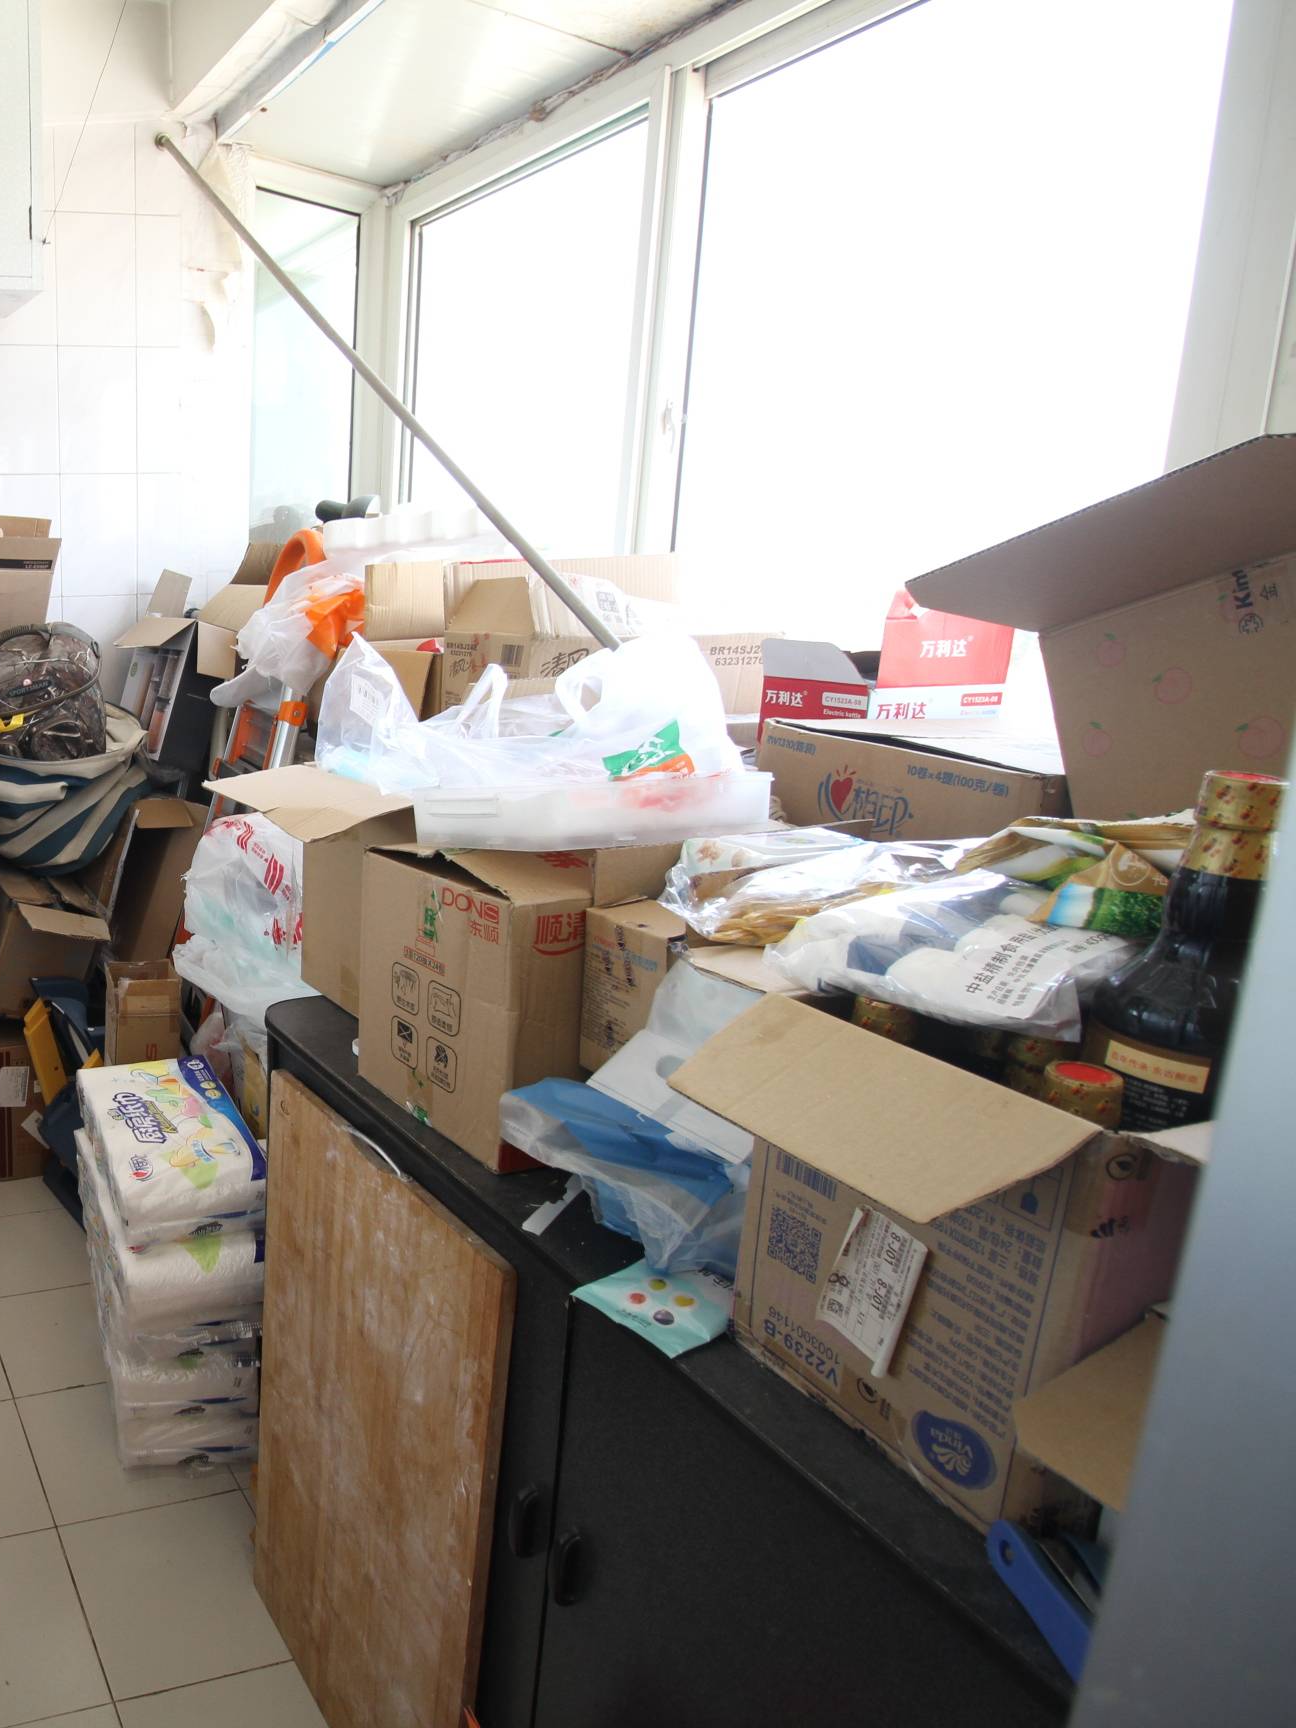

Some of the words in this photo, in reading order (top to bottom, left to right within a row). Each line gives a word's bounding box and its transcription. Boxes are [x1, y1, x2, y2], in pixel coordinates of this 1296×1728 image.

[920, 639, 967, 658] 万利达
[765, 690, 803, 707] 万利达
[876, 702, 927, 719] 万利达
[112, 1092, 167, 1144] 厨房纸巾
[763, 1317, 840, 1388] V2239-B
[929, 1427, 973, 1458] Vinda
